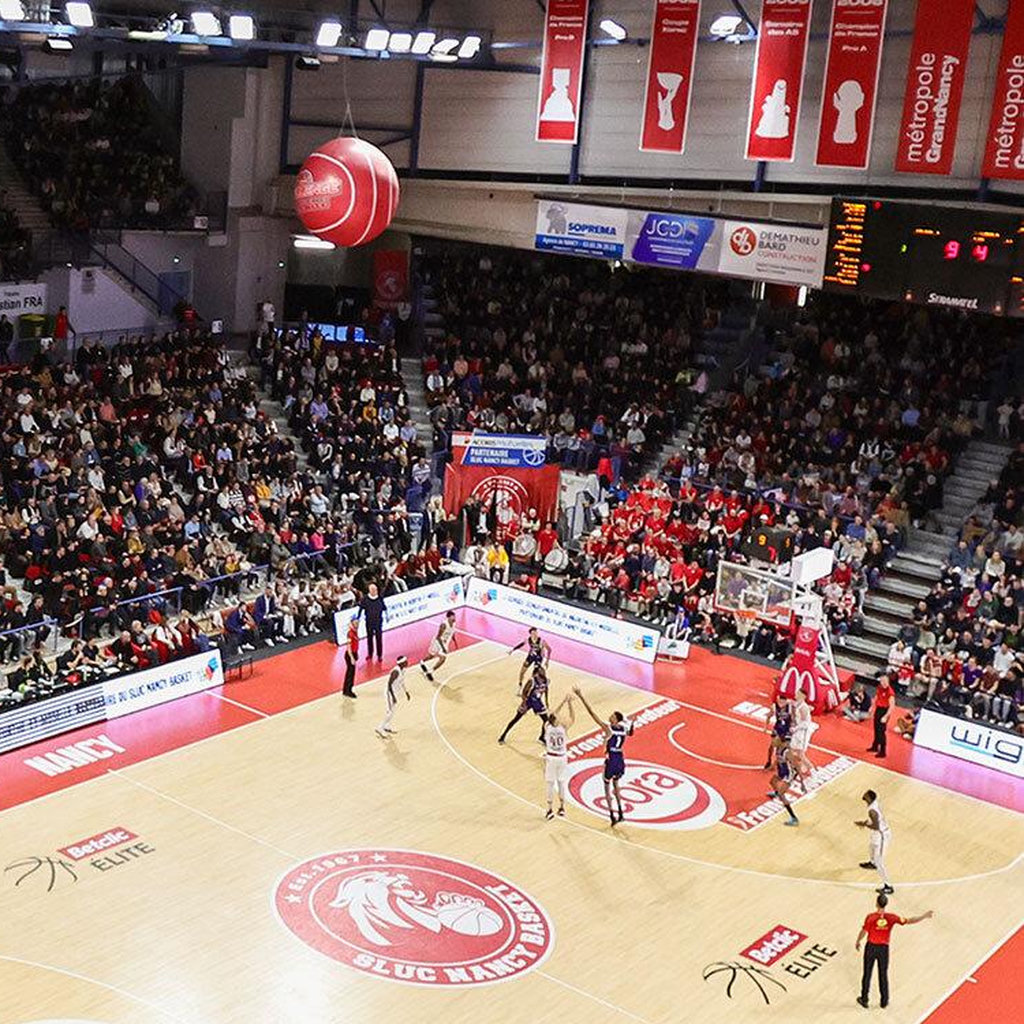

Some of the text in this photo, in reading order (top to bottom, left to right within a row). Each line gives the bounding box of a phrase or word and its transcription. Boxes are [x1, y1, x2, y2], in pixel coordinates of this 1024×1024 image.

[906, 53, 936, 162] métropole
[925, 55, 960, 163] GrandNancy
[994, 55, 1024, 168] métropole
[568, 222, 617, 236] SOPREMA
[758, 240, 786, 252] BARD
[759, 231, 820, 246] DEMATHIEU
[23, 295, 43, 308] FRA
[24, 734, 126, 777] NANCY
[66, 831, 130, 859] Betclic
[352, 883, 546, 983] SLUC NANCY BASKET
[748, 929, 800, 964] Betclic
